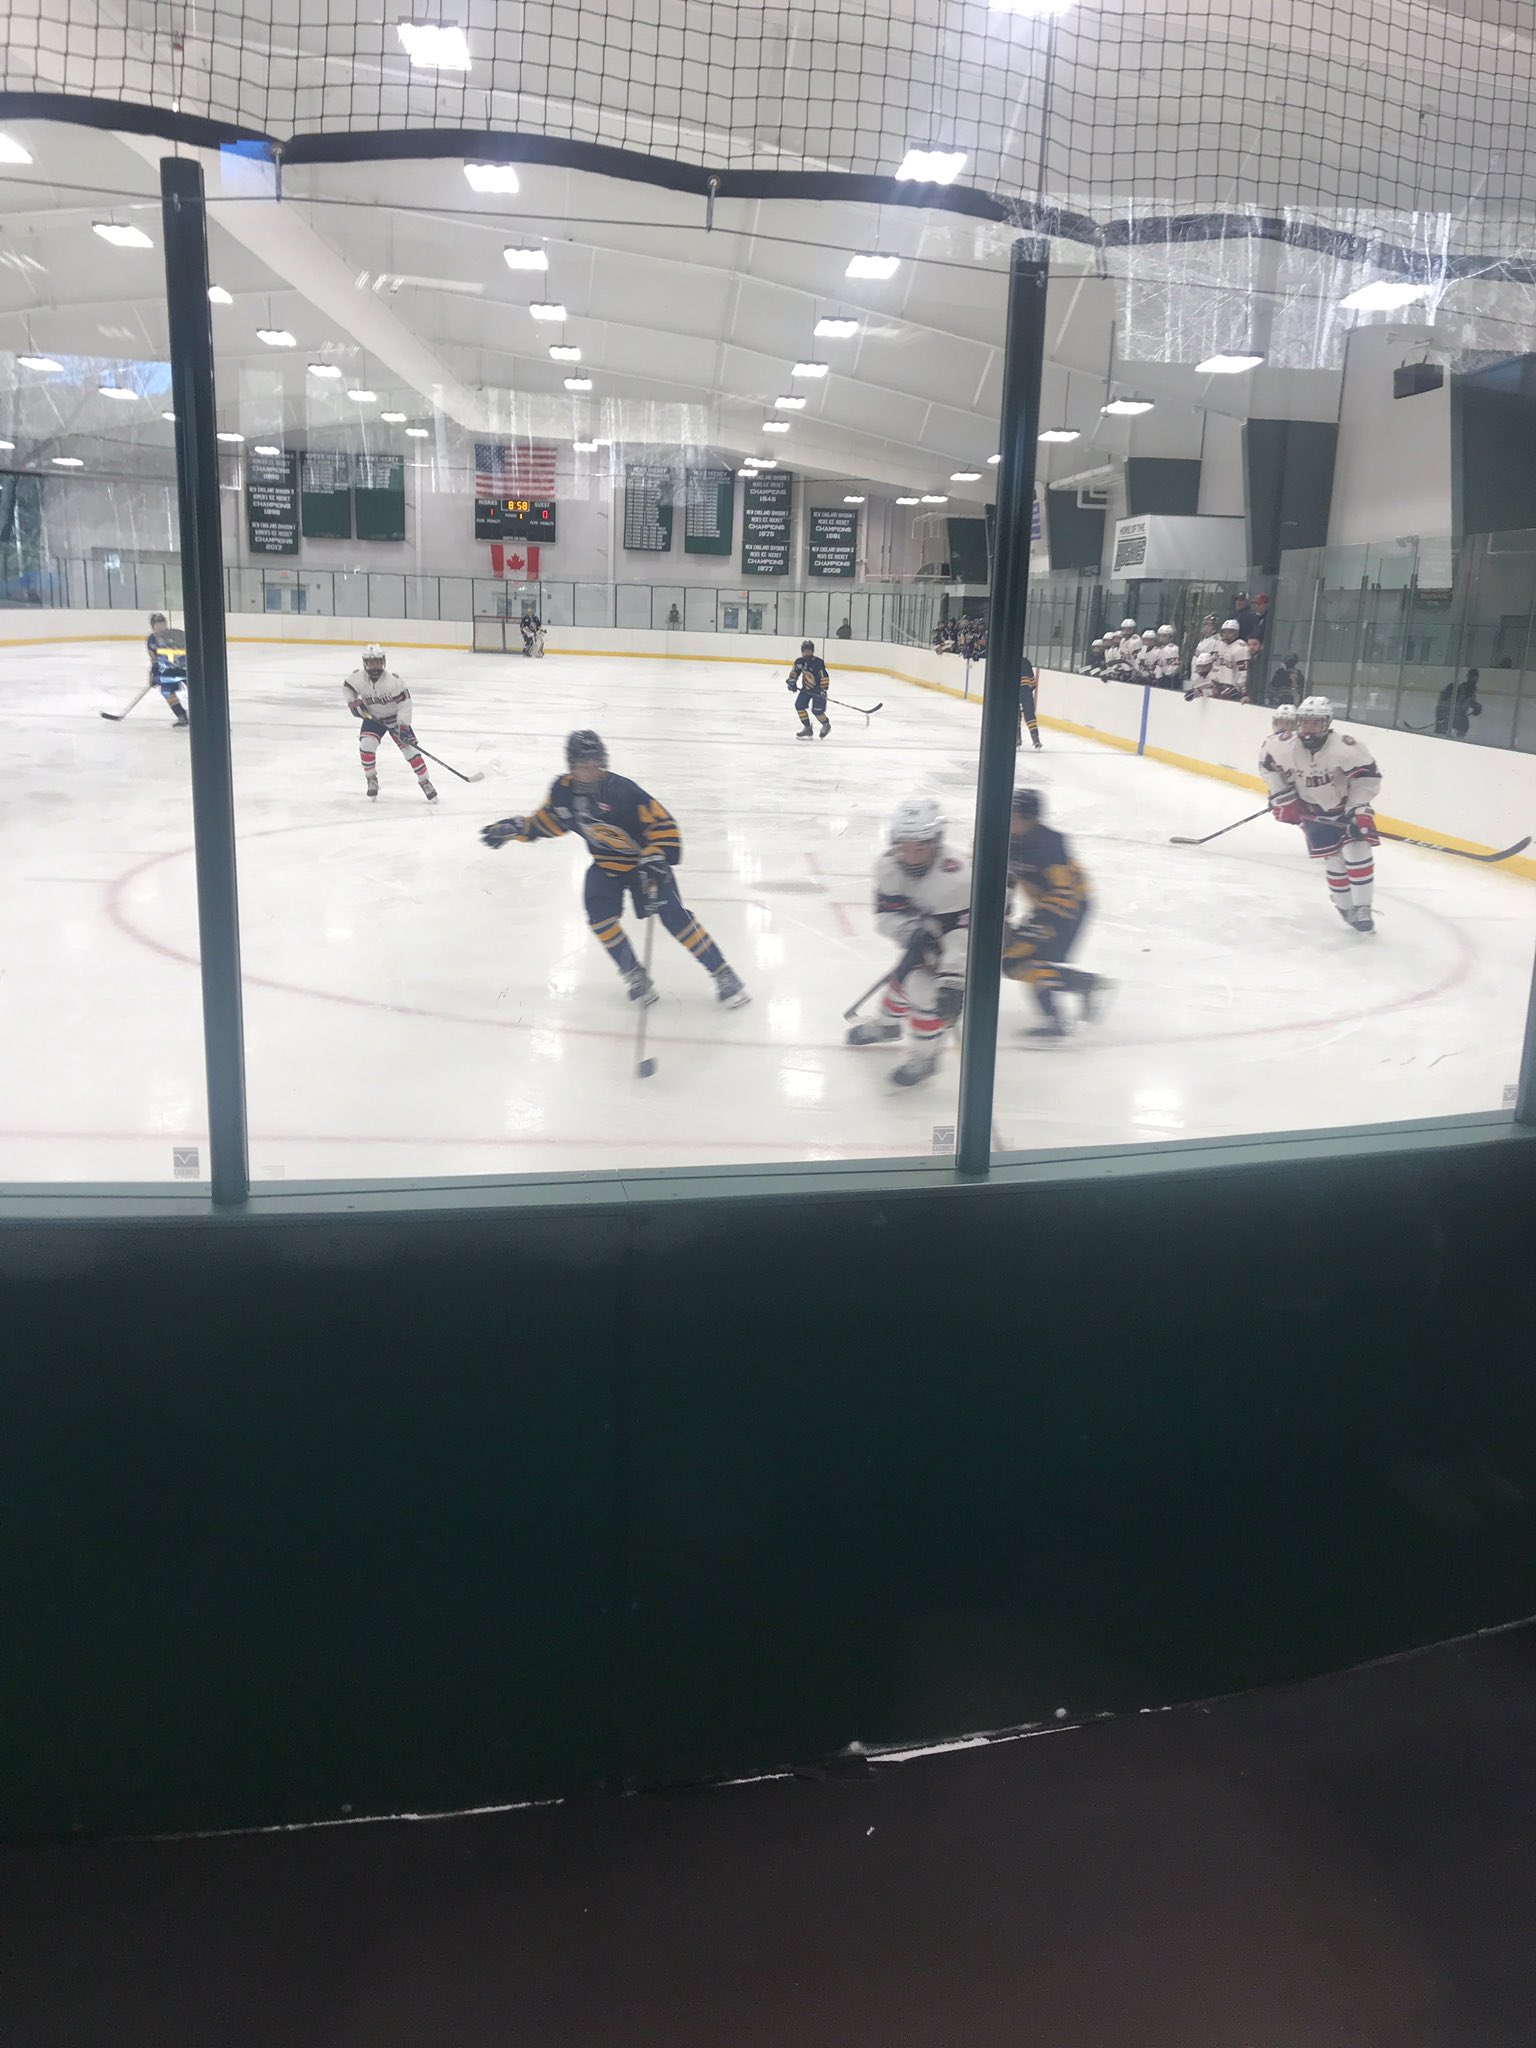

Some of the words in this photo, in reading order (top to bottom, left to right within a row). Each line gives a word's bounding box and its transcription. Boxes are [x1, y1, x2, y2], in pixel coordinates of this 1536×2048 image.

[252, 466, 290, 474] CHAMPIONS
[253, 501, 291, 509] CHAMPIONS
[508, 501, 528, 510] 8:58
[543, 510, 548, 519] 0
[1120, 525, 1131, 534] HOME
[1137, 523, 1145, 532] THE
[255, 536, 293, 544] CHAMPIONS
